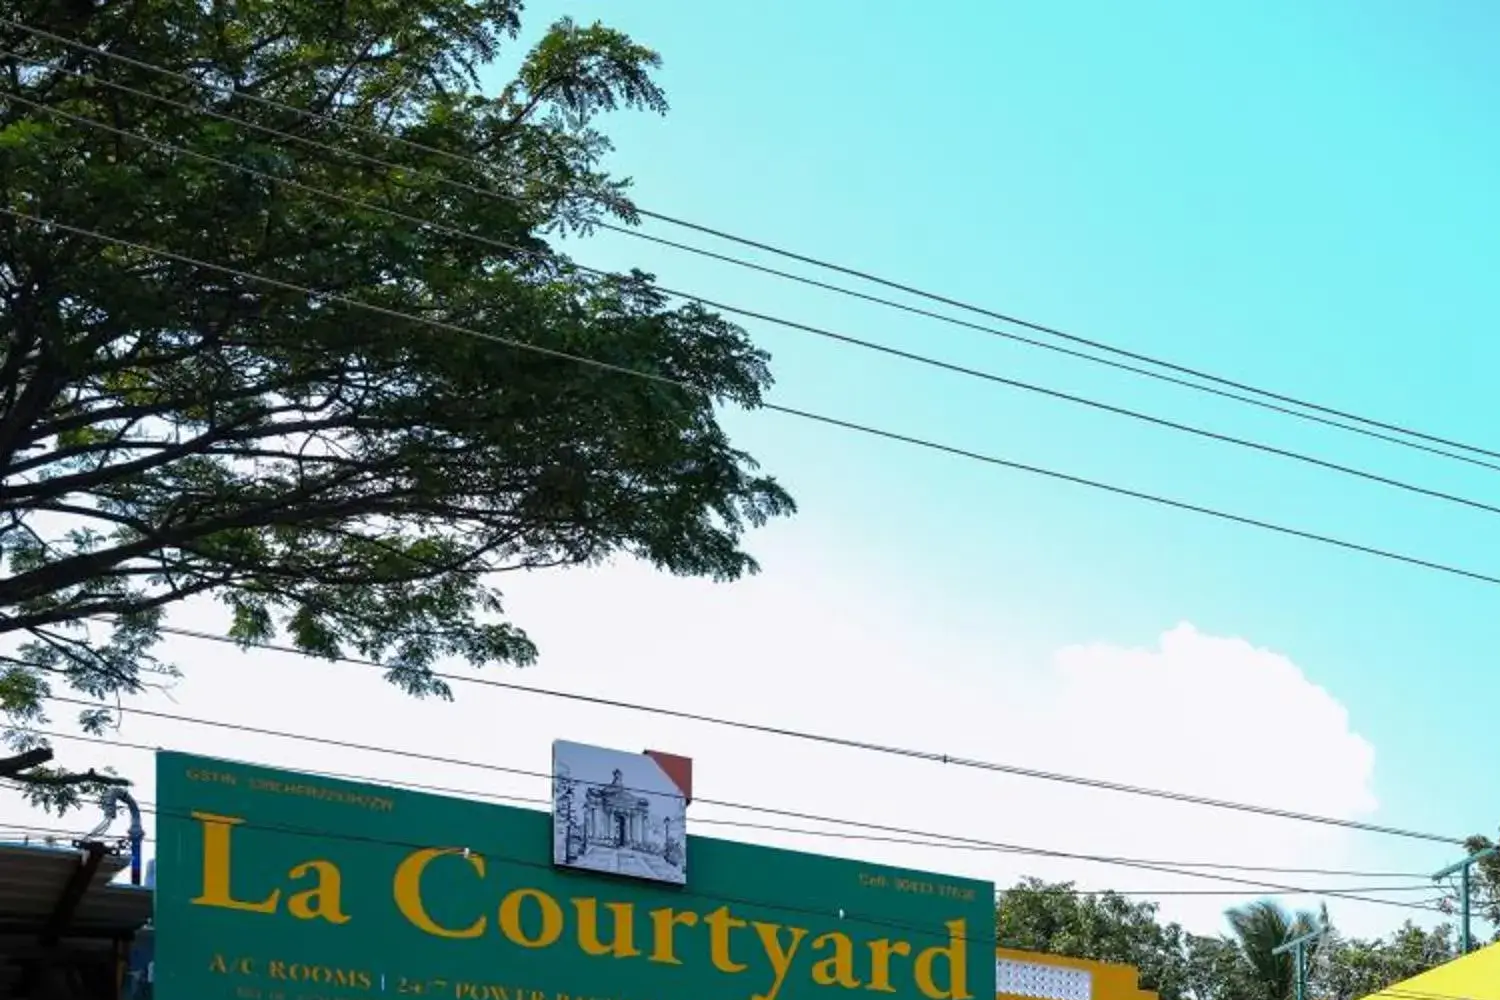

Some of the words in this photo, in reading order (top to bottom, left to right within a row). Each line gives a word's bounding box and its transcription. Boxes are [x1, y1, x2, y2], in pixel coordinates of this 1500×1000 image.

[189, 810, 352, 925] La
[209, 954, 254, 975] A/C
[268, 960, 373, 990] ROOMS
